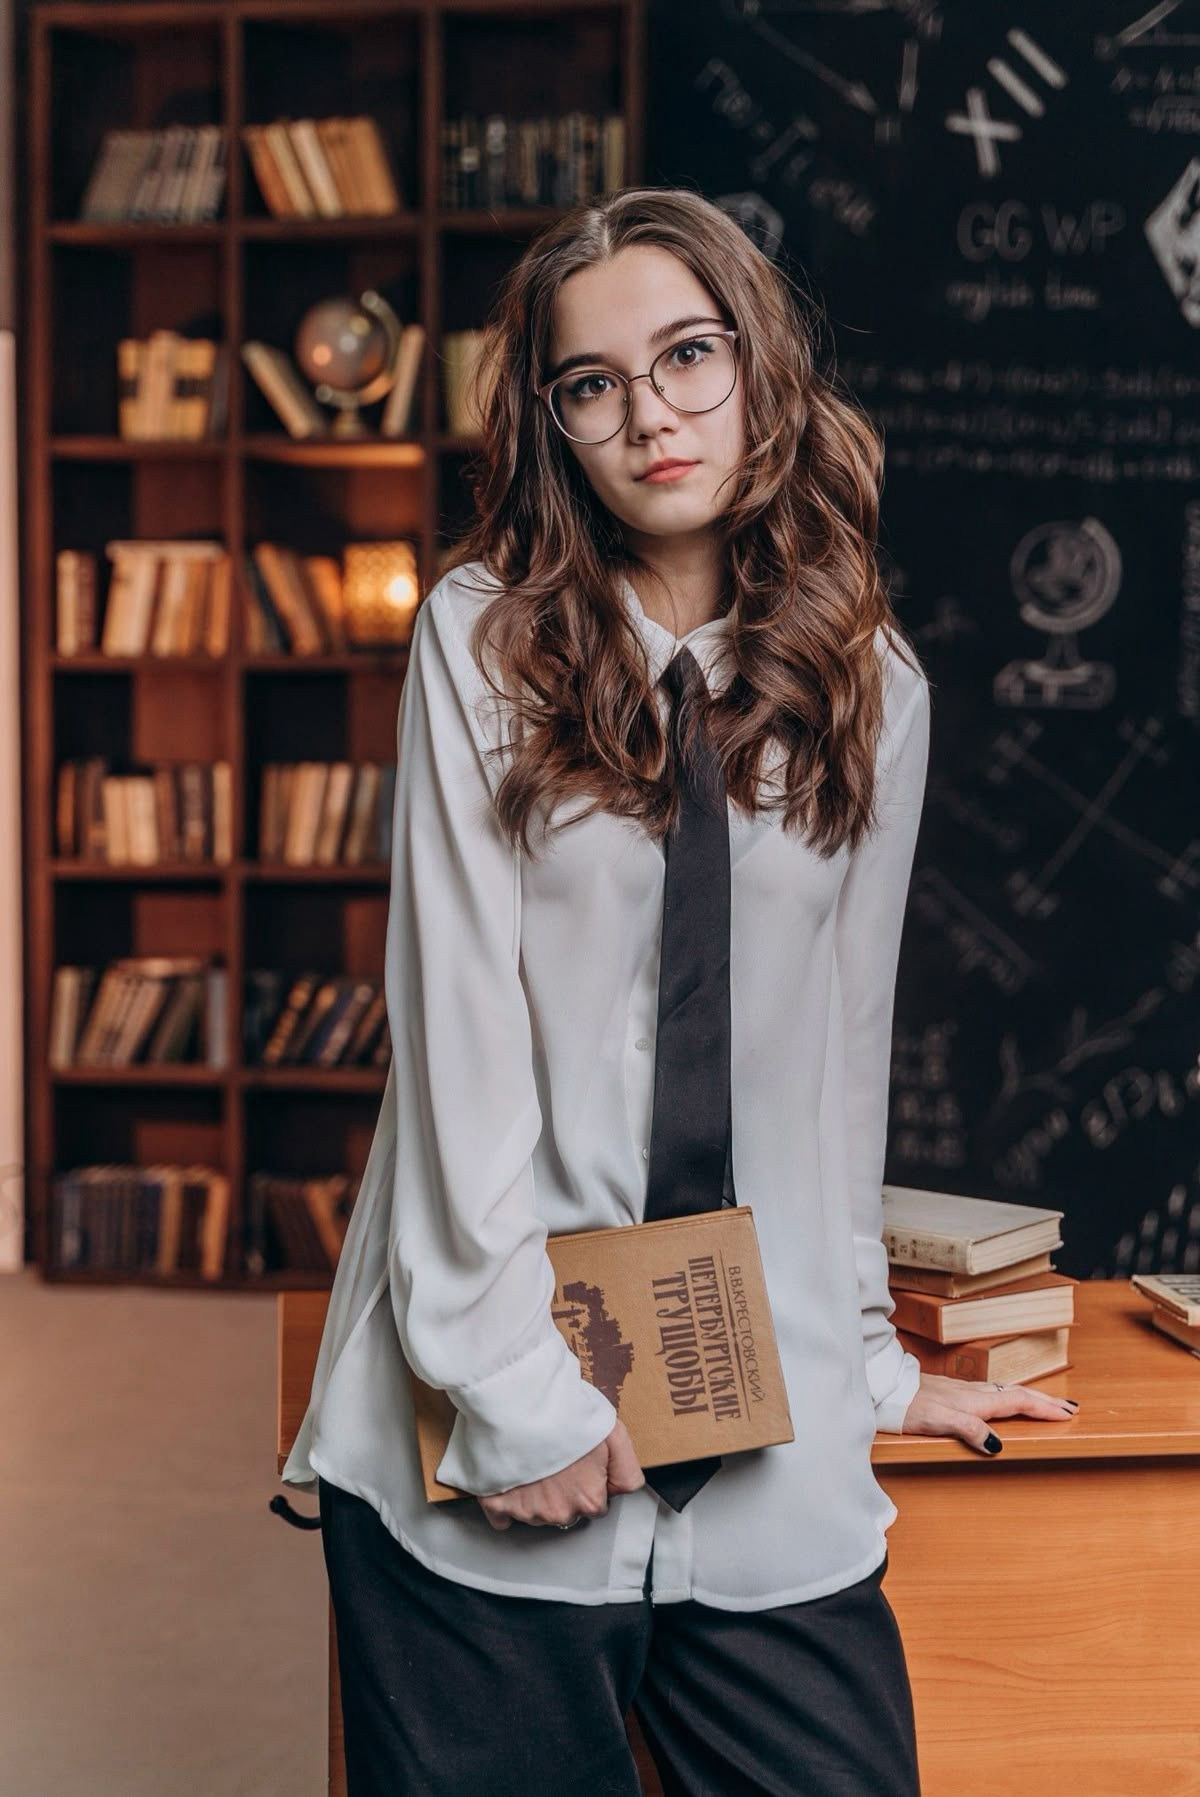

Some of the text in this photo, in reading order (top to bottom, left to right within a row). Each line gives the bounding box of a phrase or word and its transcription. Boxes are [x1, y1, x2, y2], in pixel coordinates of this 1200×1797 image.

[957, 200, 1126, 262] GG WP
[652, 1271, 709, 1416] ТРУЩОБЫ
[688, 1256, 741, 1422] ПЕТЕРБУРГСКИЕ
